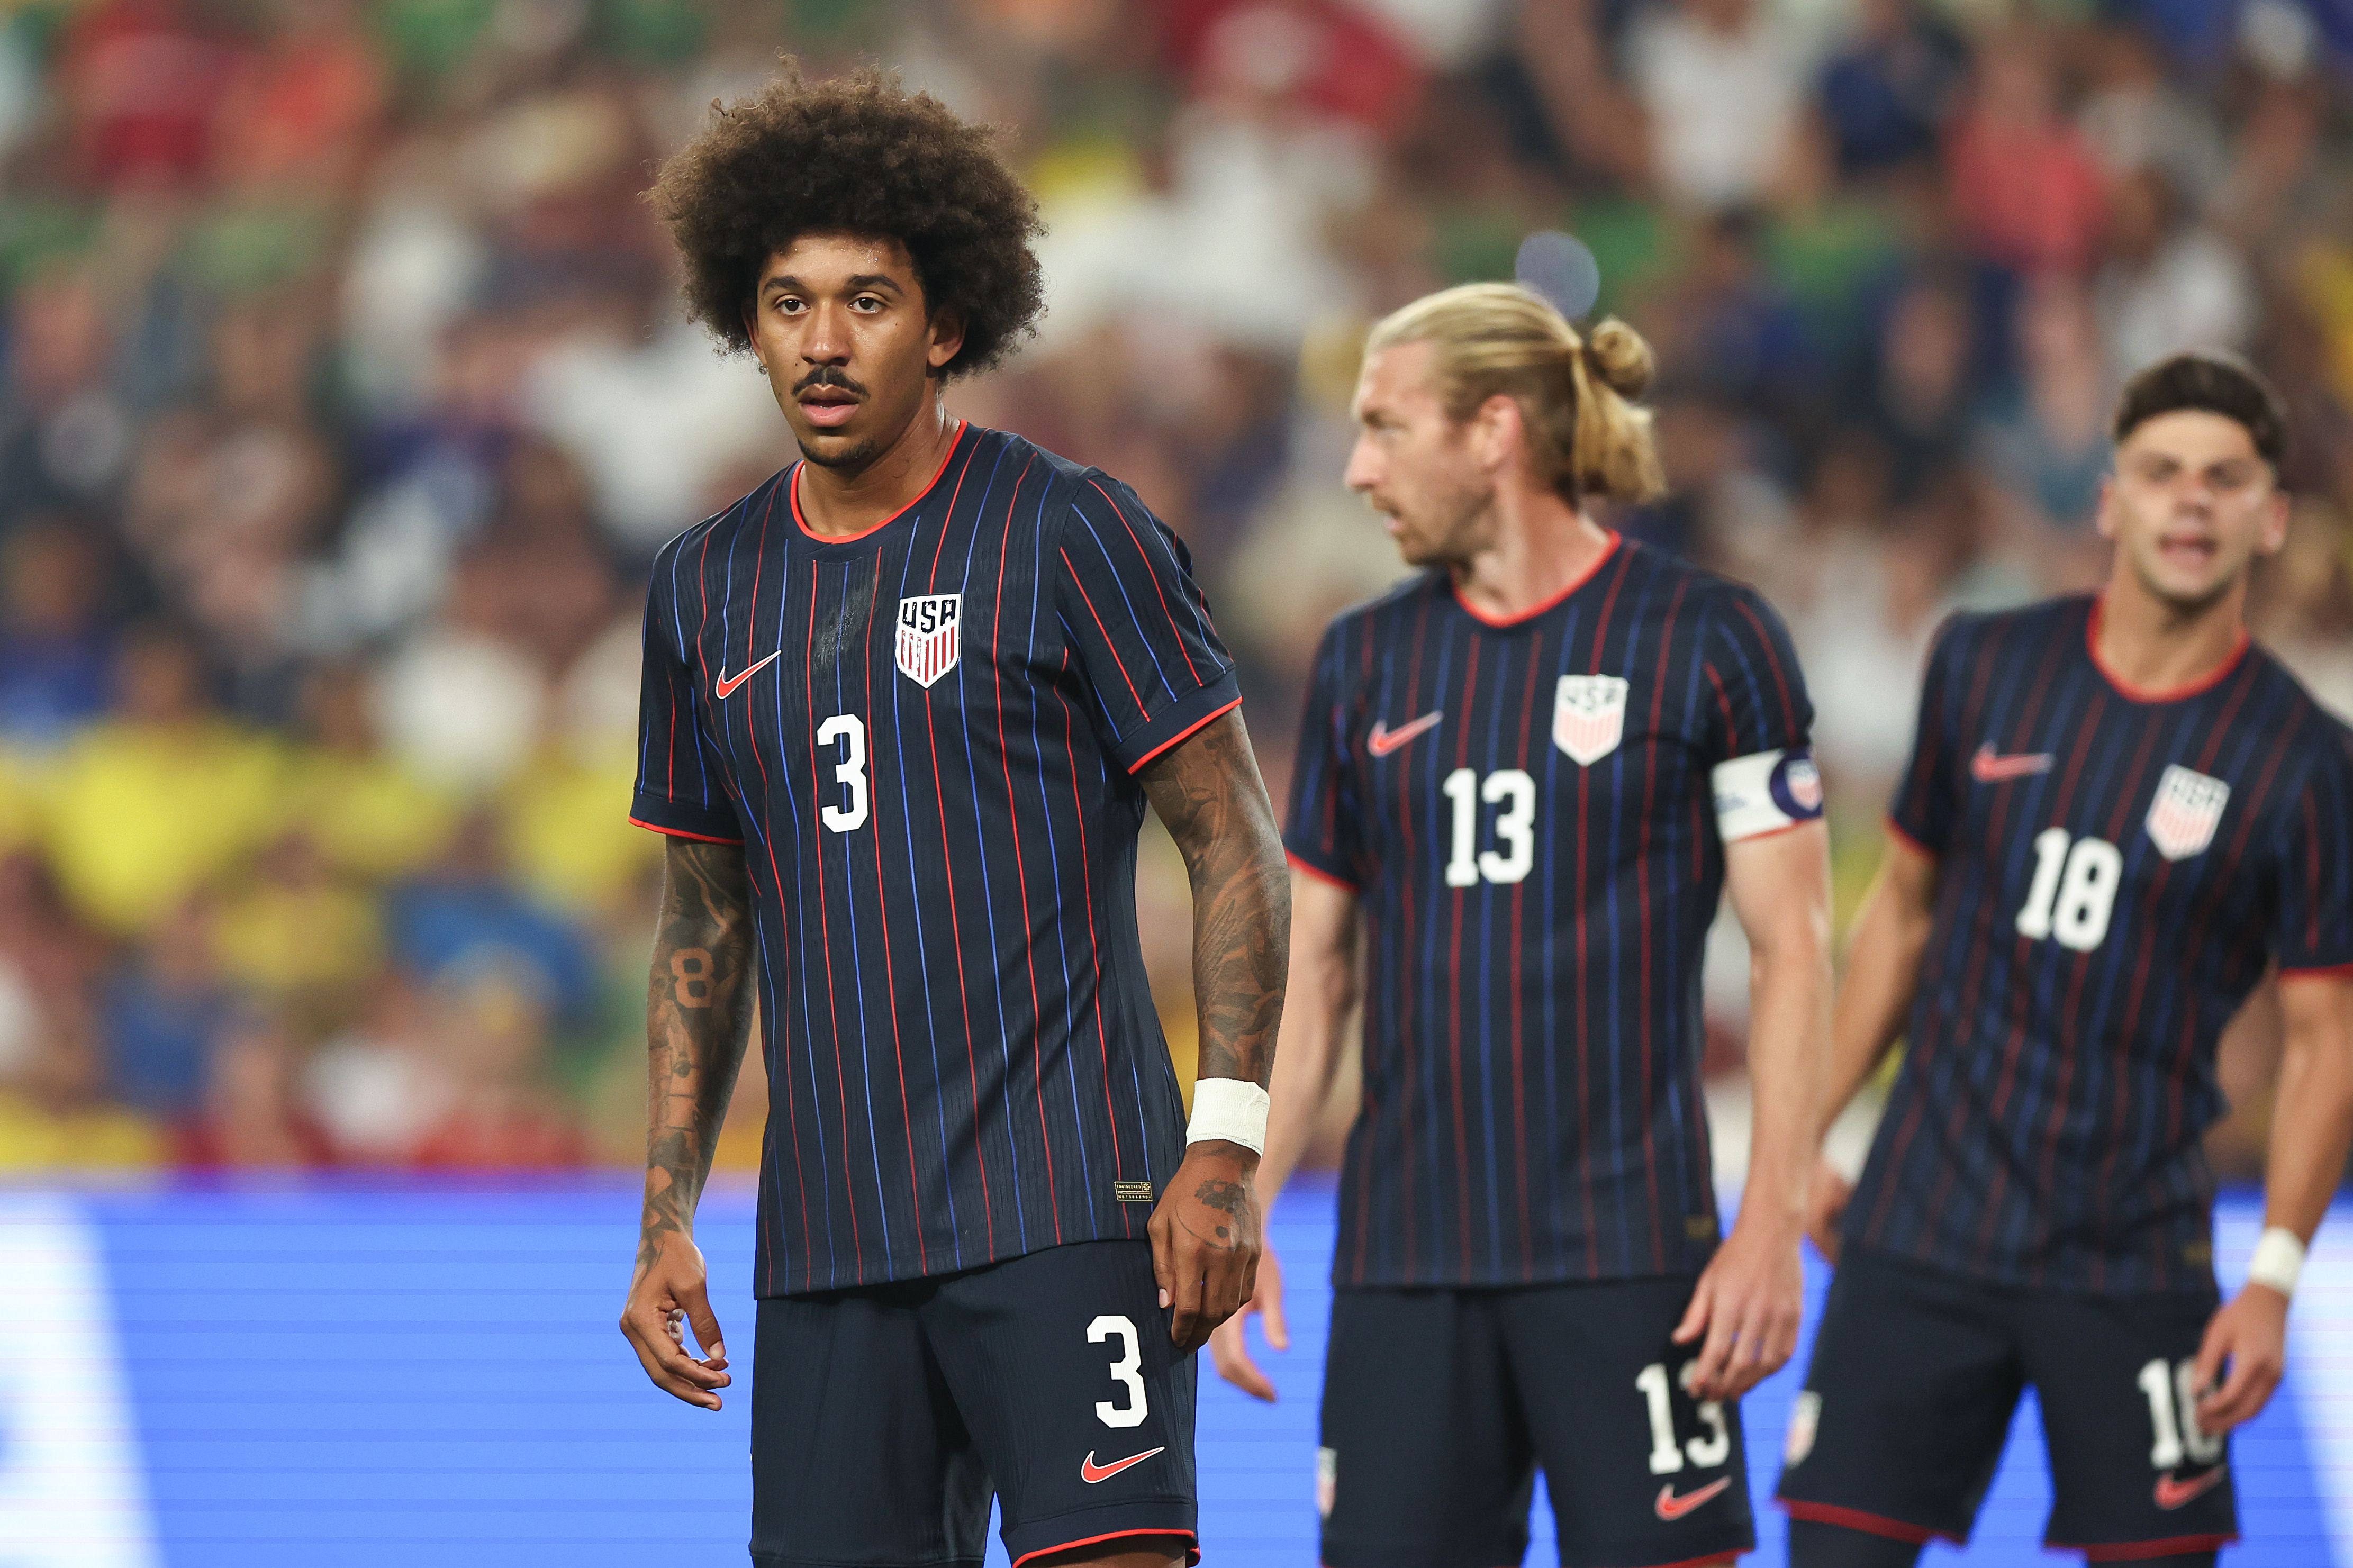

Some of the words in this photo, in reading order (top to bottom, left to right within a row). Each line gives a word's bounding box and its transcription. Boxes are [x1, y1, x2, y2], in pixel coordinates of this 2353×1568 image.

[902, 599, 956, 635] USA
[817, 713, 868, 833] 3
[1443, 767, 1536, 887] 13
[2015, 827, 2123, 952] 18
[671, 948, 714, 1008] 8
[1087, 1315, 1148, 1428] 3
